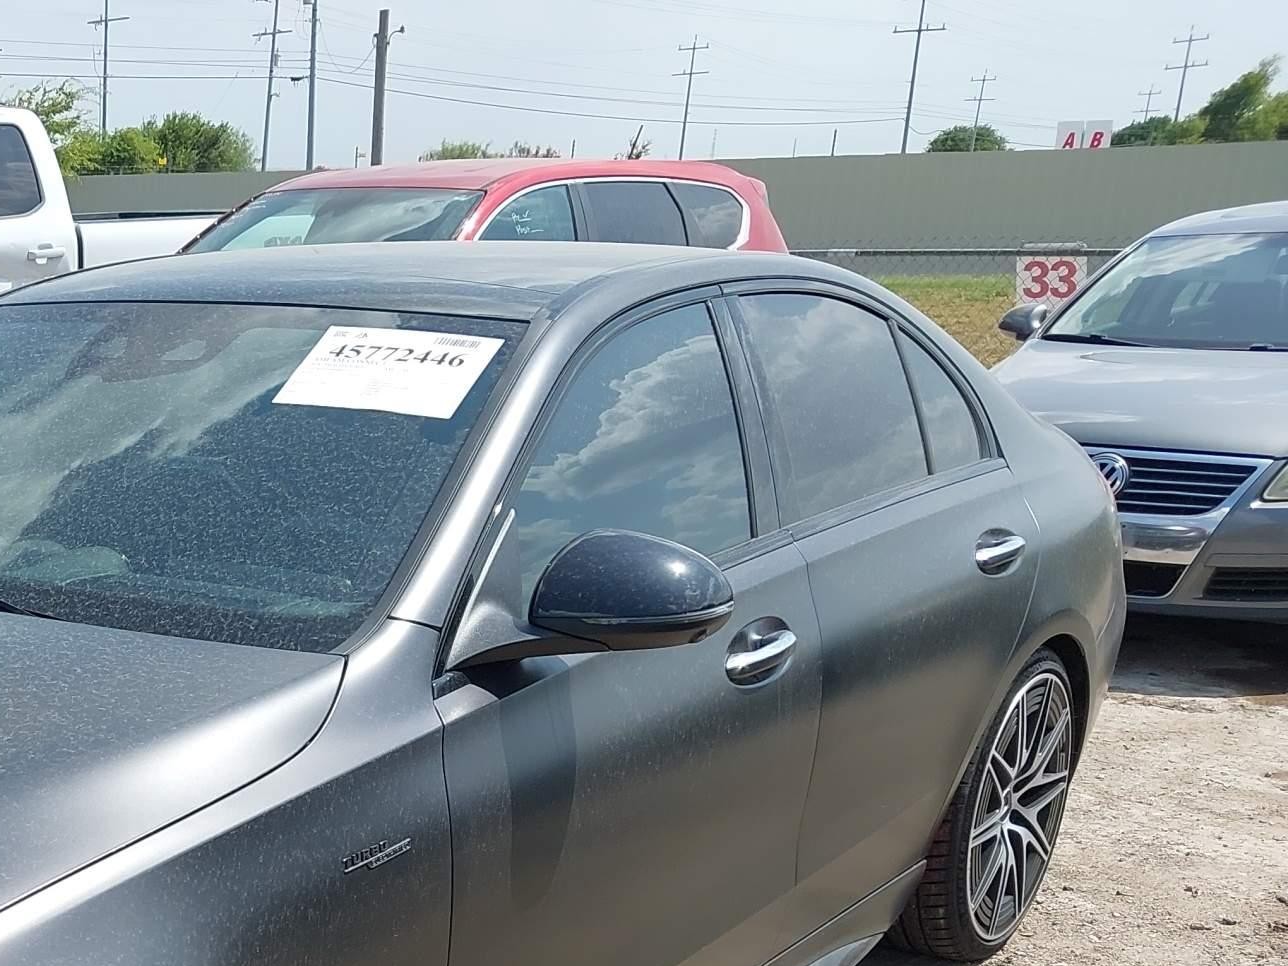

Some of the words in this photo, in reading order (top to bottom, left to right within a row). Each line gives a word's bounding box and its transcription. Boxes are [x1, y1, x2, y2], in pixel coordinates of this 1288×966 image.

[1062, 132, 1076, 149] A
[1089, 131, 1104, 149] B
[1022, 260, 1077, 299] 33
[329, 344, 469, 368] 45772446
